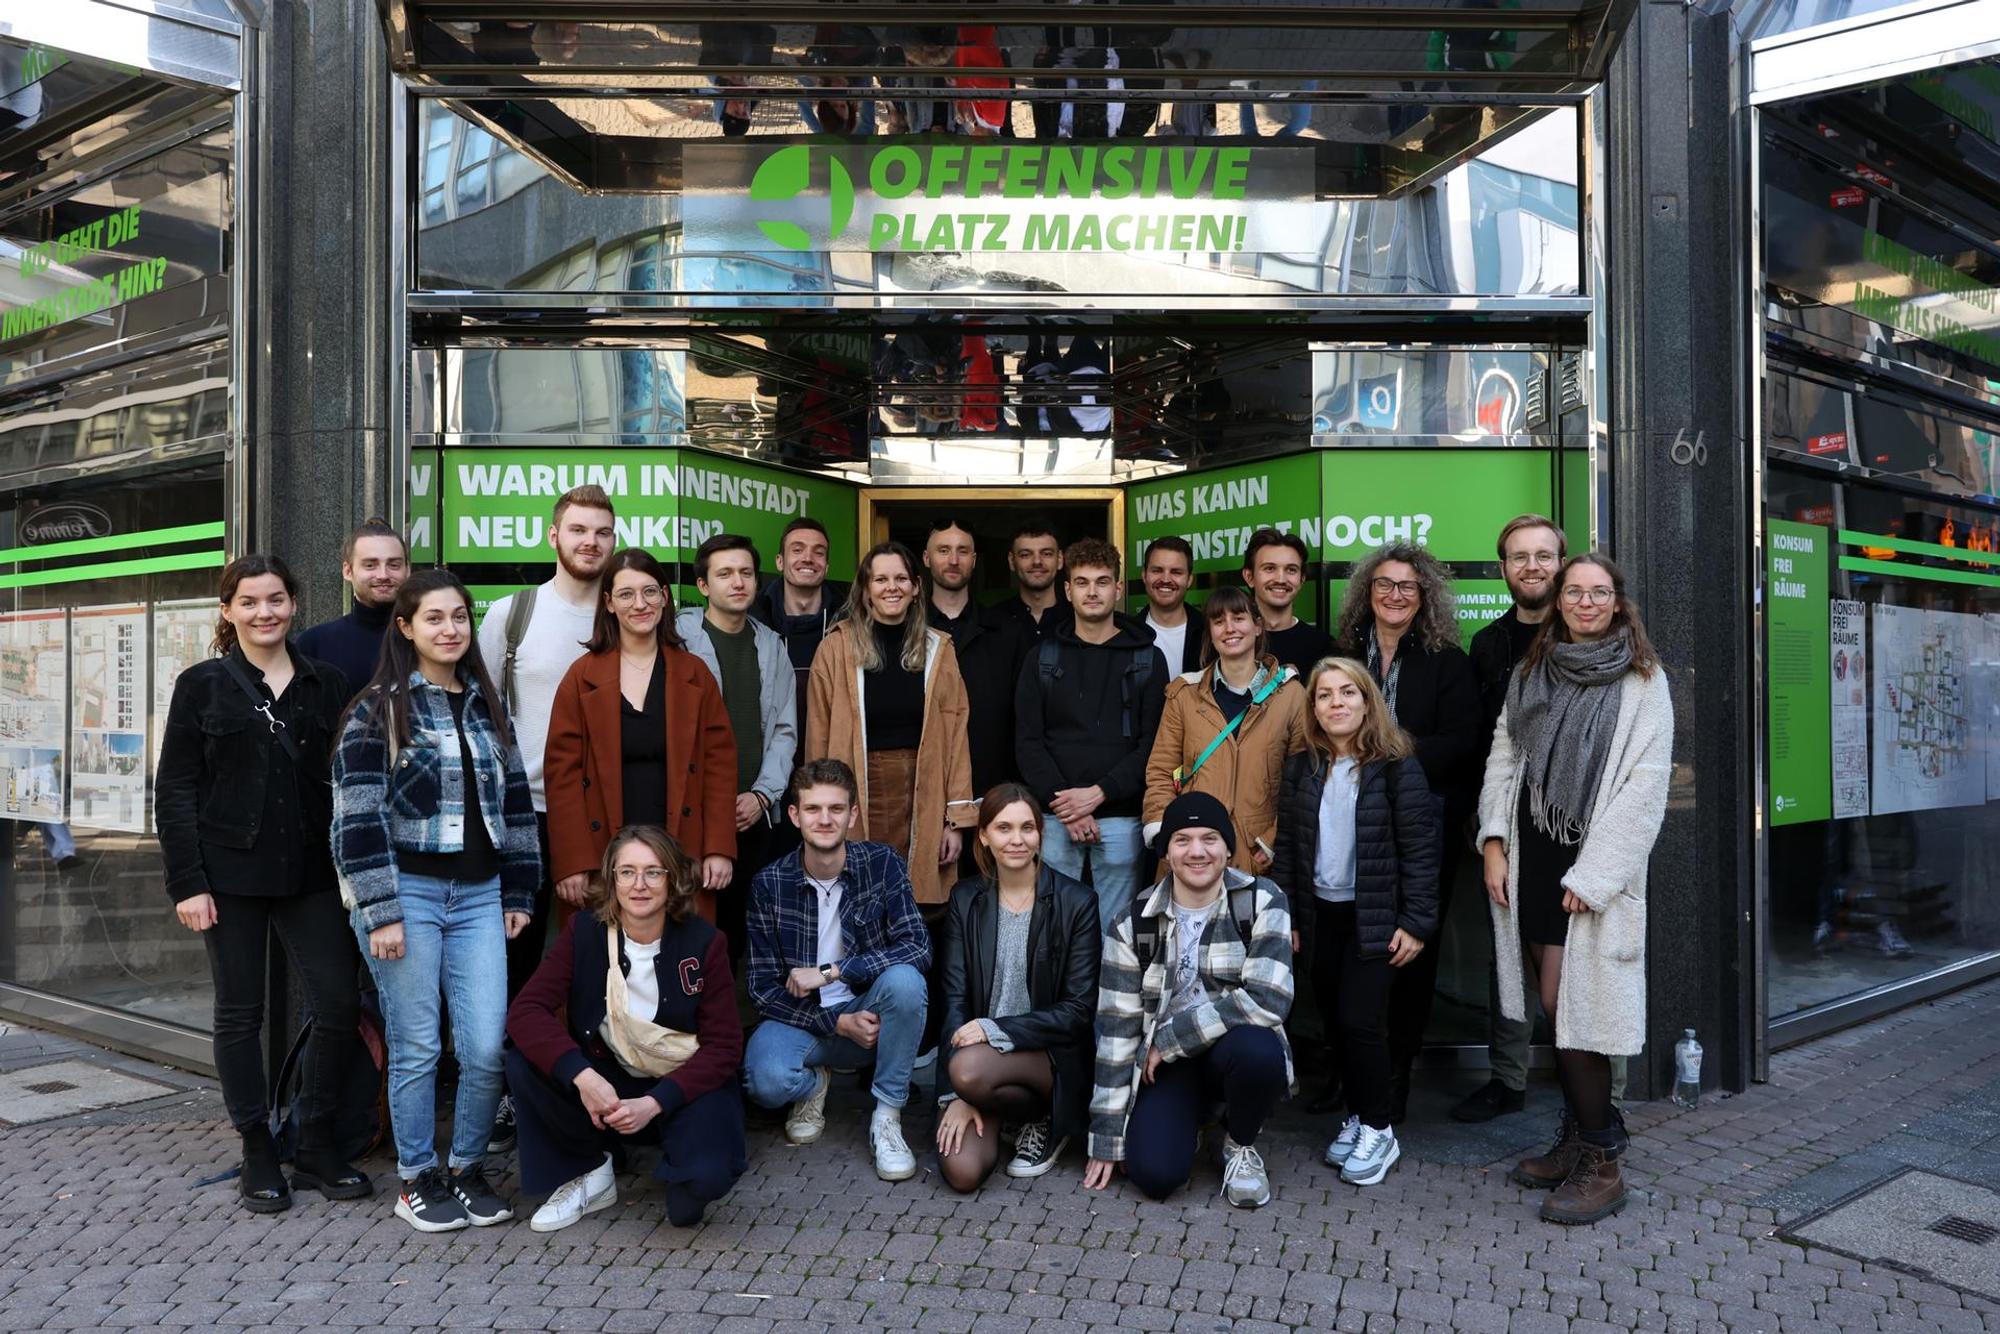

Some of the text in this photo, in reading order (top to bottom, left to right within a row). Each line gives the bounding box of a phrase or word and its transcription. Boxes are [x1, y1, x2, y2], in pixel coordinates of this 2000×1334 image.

[869, 146, 1251, 200] OFFENSIVE
[56, 219, 104, 265] GEHT
[107, 204, 141, 248] DIE
[871, 214, 1247, 251] PLATZ MACHEN!
[1, 256, 167, 341] INNENSTADT HIN?
[1904, 303, 1931, 340] ALS
[1671, 427, 1708, 466] 66
[458, 464, 629, 496] WARUM
[641, 464, 810, 517] INNENSTADT
[1136, 475, 1268, 523] WAS KANN
[459, 516, 543, 548] NEU
[615, 516, 724, 548] NKEN?
[1136, 513, 1433, 567] INNSTAT NOCH?
[1774, 534, 1814, 553] KONSUM
[1774, 558, 1793, 574] FREI
[1774, 577, 1806, 598] RÄUME
[1833, 602, 1865, 617] KONSUM
[1833, 616, 1849, 630] FREI
[679, 957, 704, 995] C
